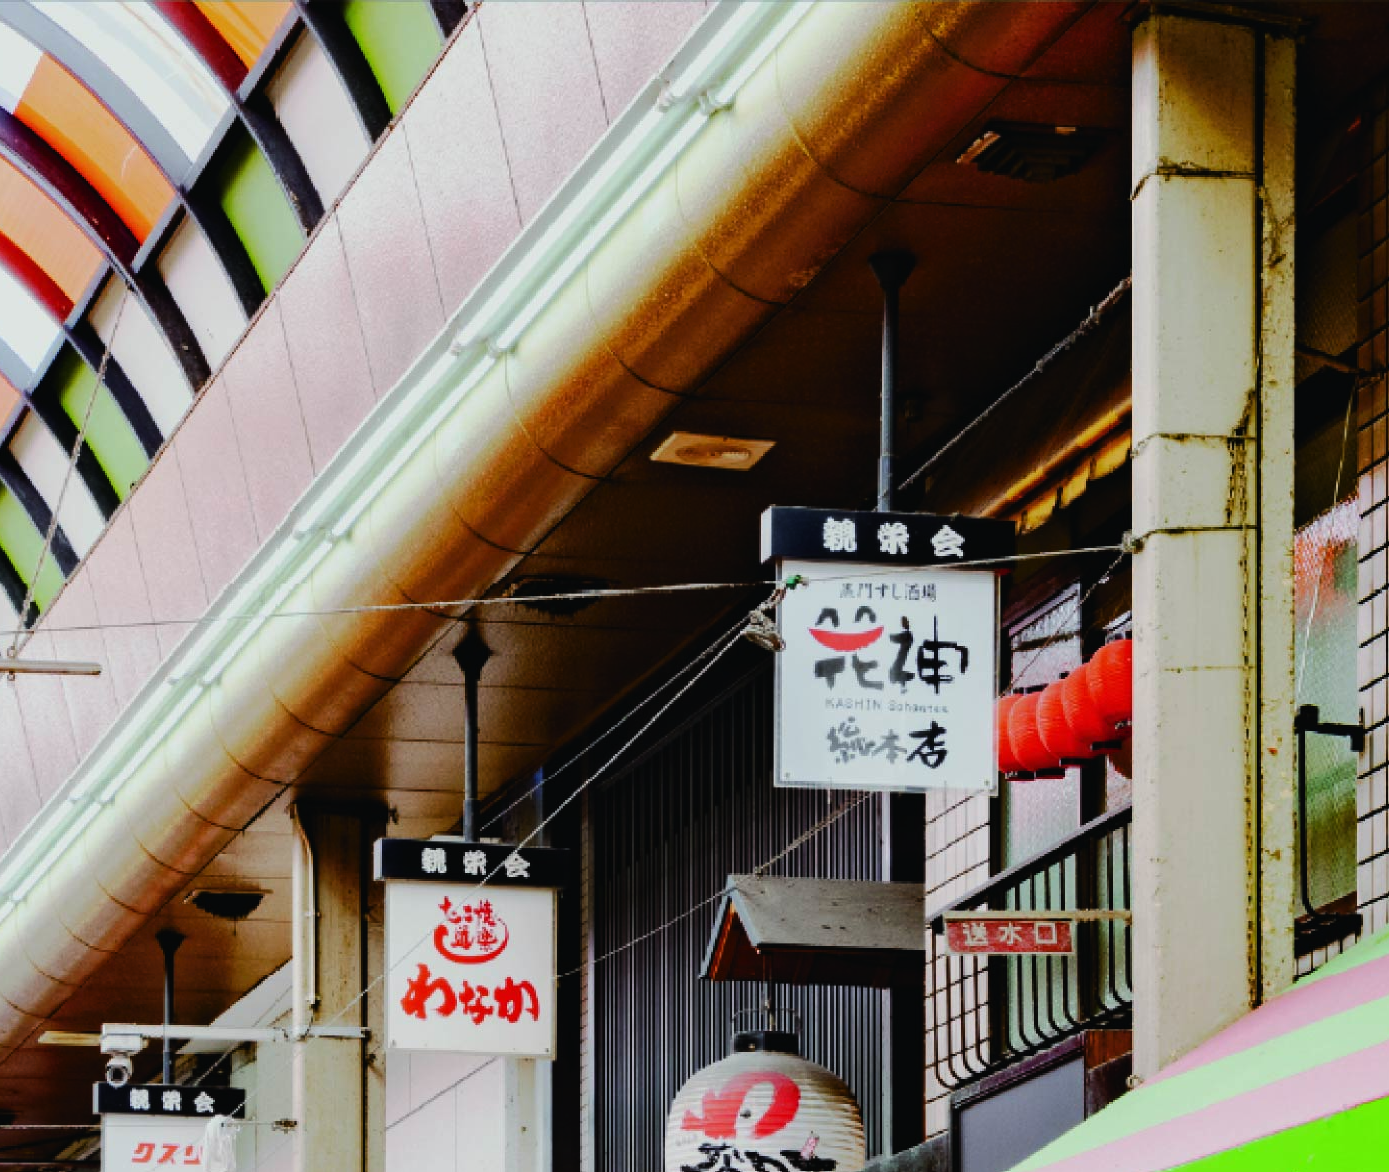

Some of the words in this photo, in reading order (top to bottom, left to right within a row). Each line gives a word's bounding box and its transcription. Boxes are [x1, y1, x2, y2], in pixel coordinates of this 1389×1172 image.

[825, 698, 882, 711] KASHIN
[960, 921, 1058, 946] 送水口
[400, 963, 540, 1025] わなか
